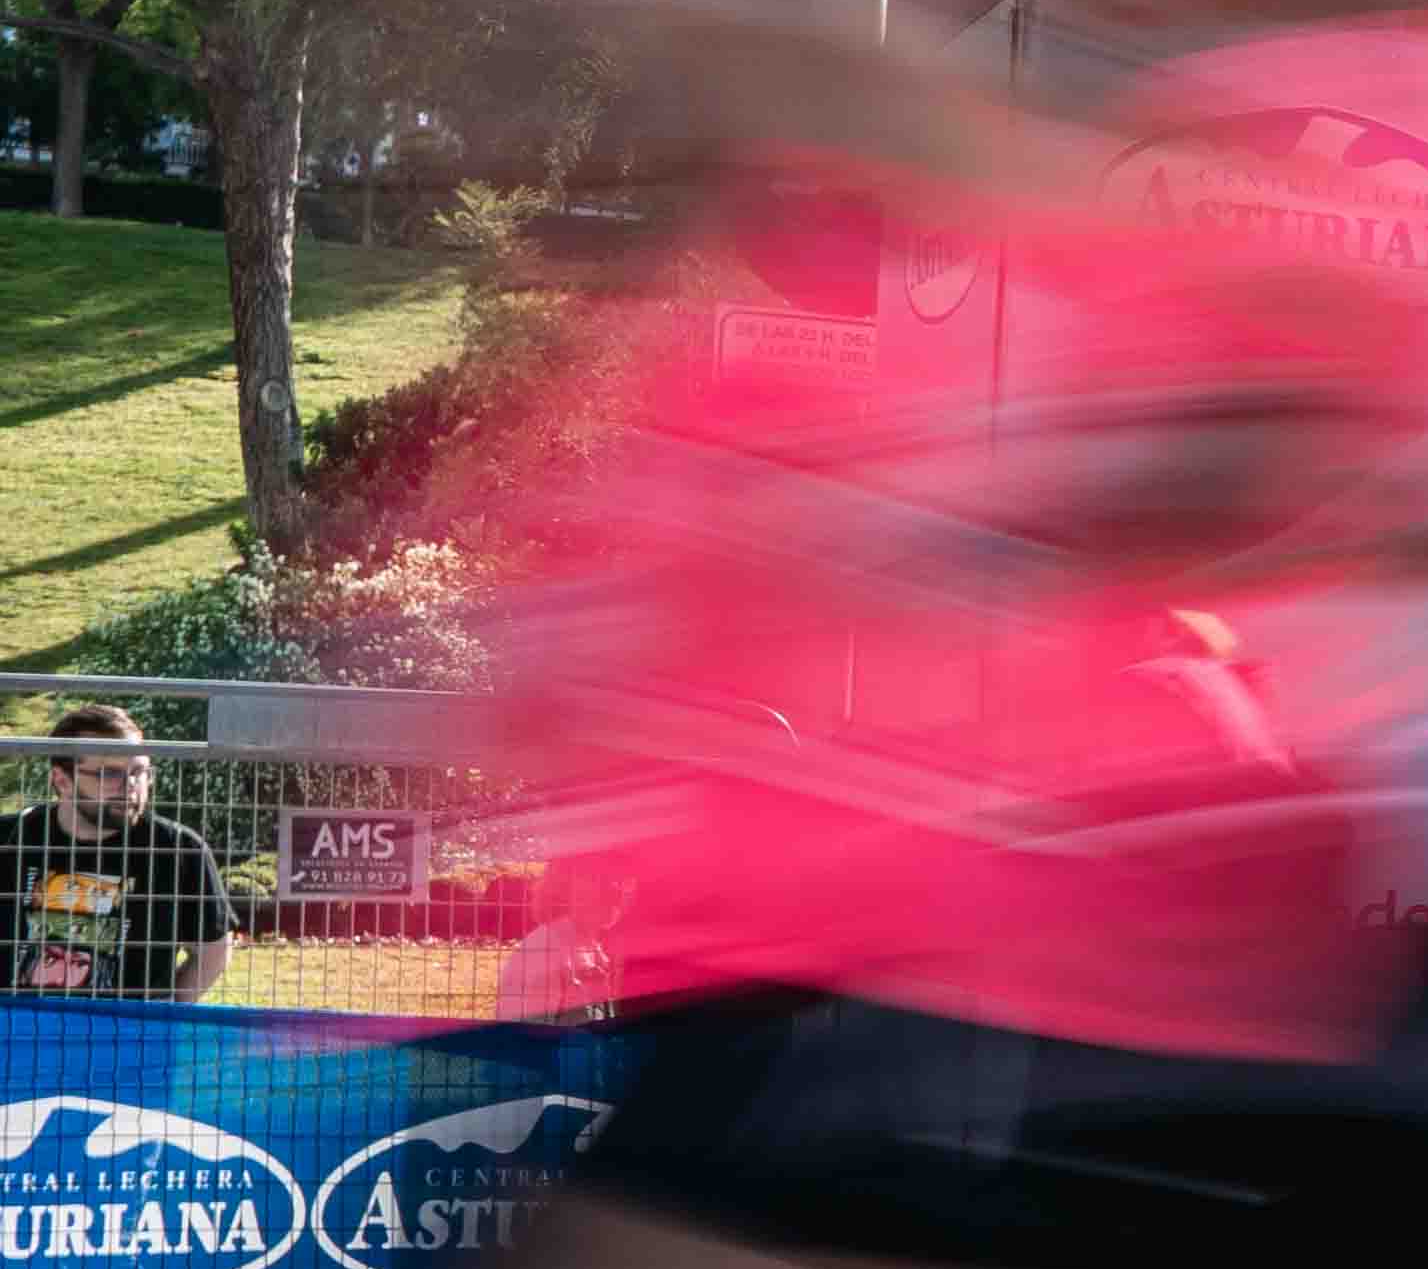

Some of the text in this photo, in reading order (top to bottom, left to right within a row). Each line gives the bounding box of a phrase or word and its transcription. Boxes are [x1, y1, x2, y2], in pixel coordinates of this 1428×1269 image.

[311, 821, 396, 859] AMS
[0, 1168, 255, 1193] TRAL LECHERA
[0, 1200, 266, 1259] URIANA
